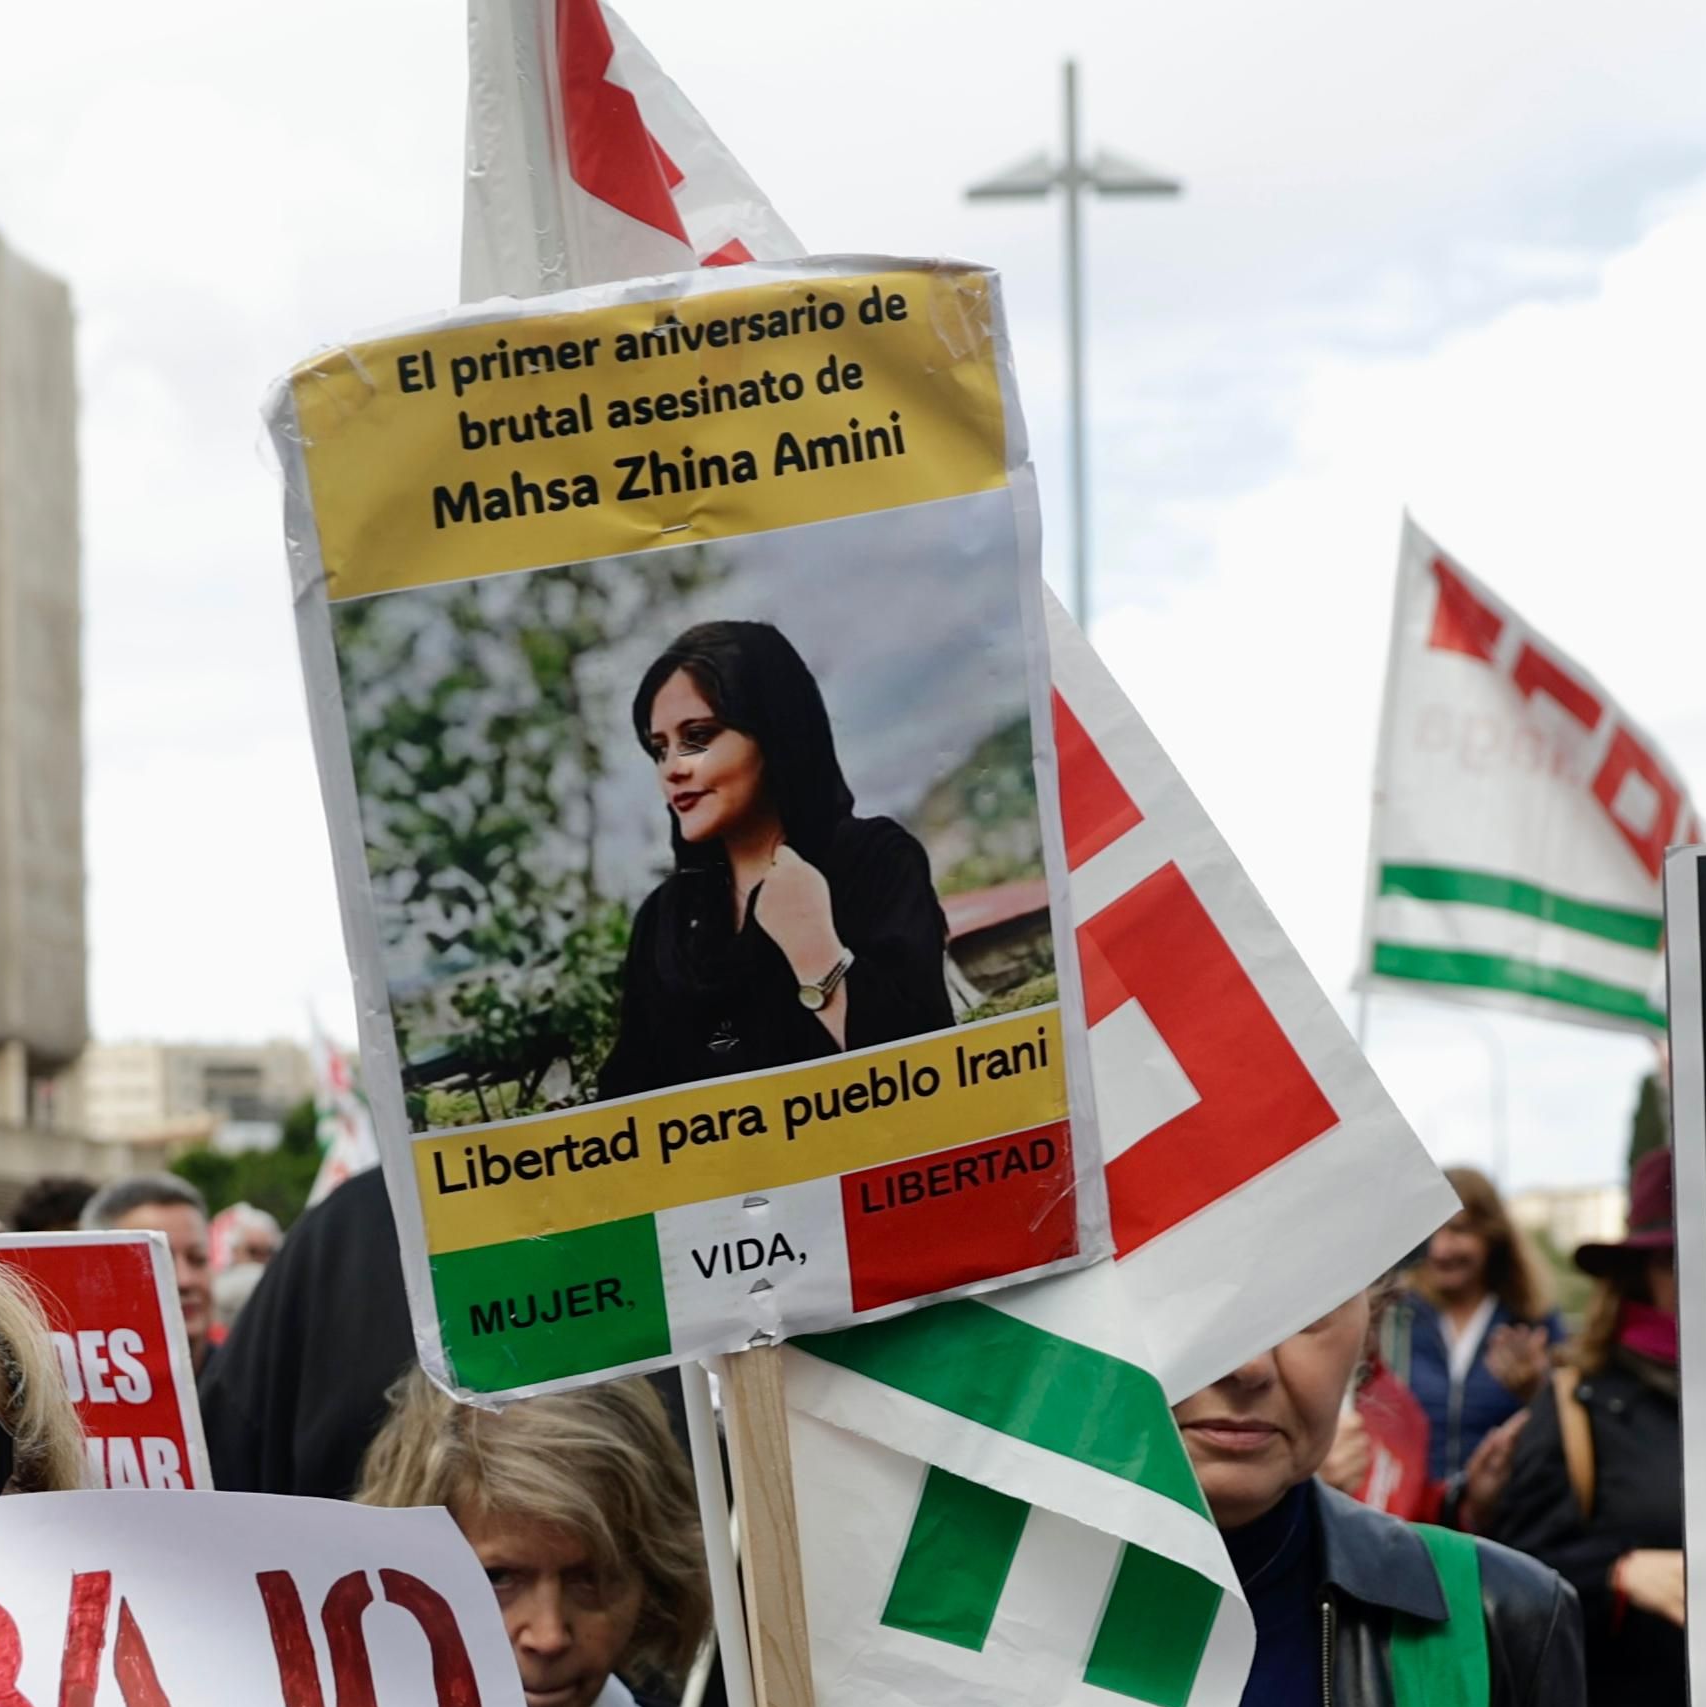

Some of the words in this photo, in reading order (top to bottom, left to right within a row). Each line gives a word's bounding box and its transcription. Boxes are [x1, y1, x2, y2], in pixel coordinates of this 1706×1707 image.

[396, 353, 435, 394] El
[450, 334, 602, 396] primer
[613, 293, 845, 363] aniversario
[858, 284, 908, 326] de
[457, 391, 593, 452] brutal
[605, 374, 805, 430] asesinato
[816, 354, 864, 395] de
[433, 466, 600, 529] Mahsa
[613, 445, 759, 504] Zhina
[772, 411, 907, 477] Amini
[433, 1117, 640, 1195] Libertad
[658, 1104, 768, 1164] para
[783, 1060, 941, 1142] pueblo
[955, 1027, 1050, 1089] Irani
[859, 1136, 1057, 1215] LIBERTAD
[691, 1231, 808, 1280] VIDA,
